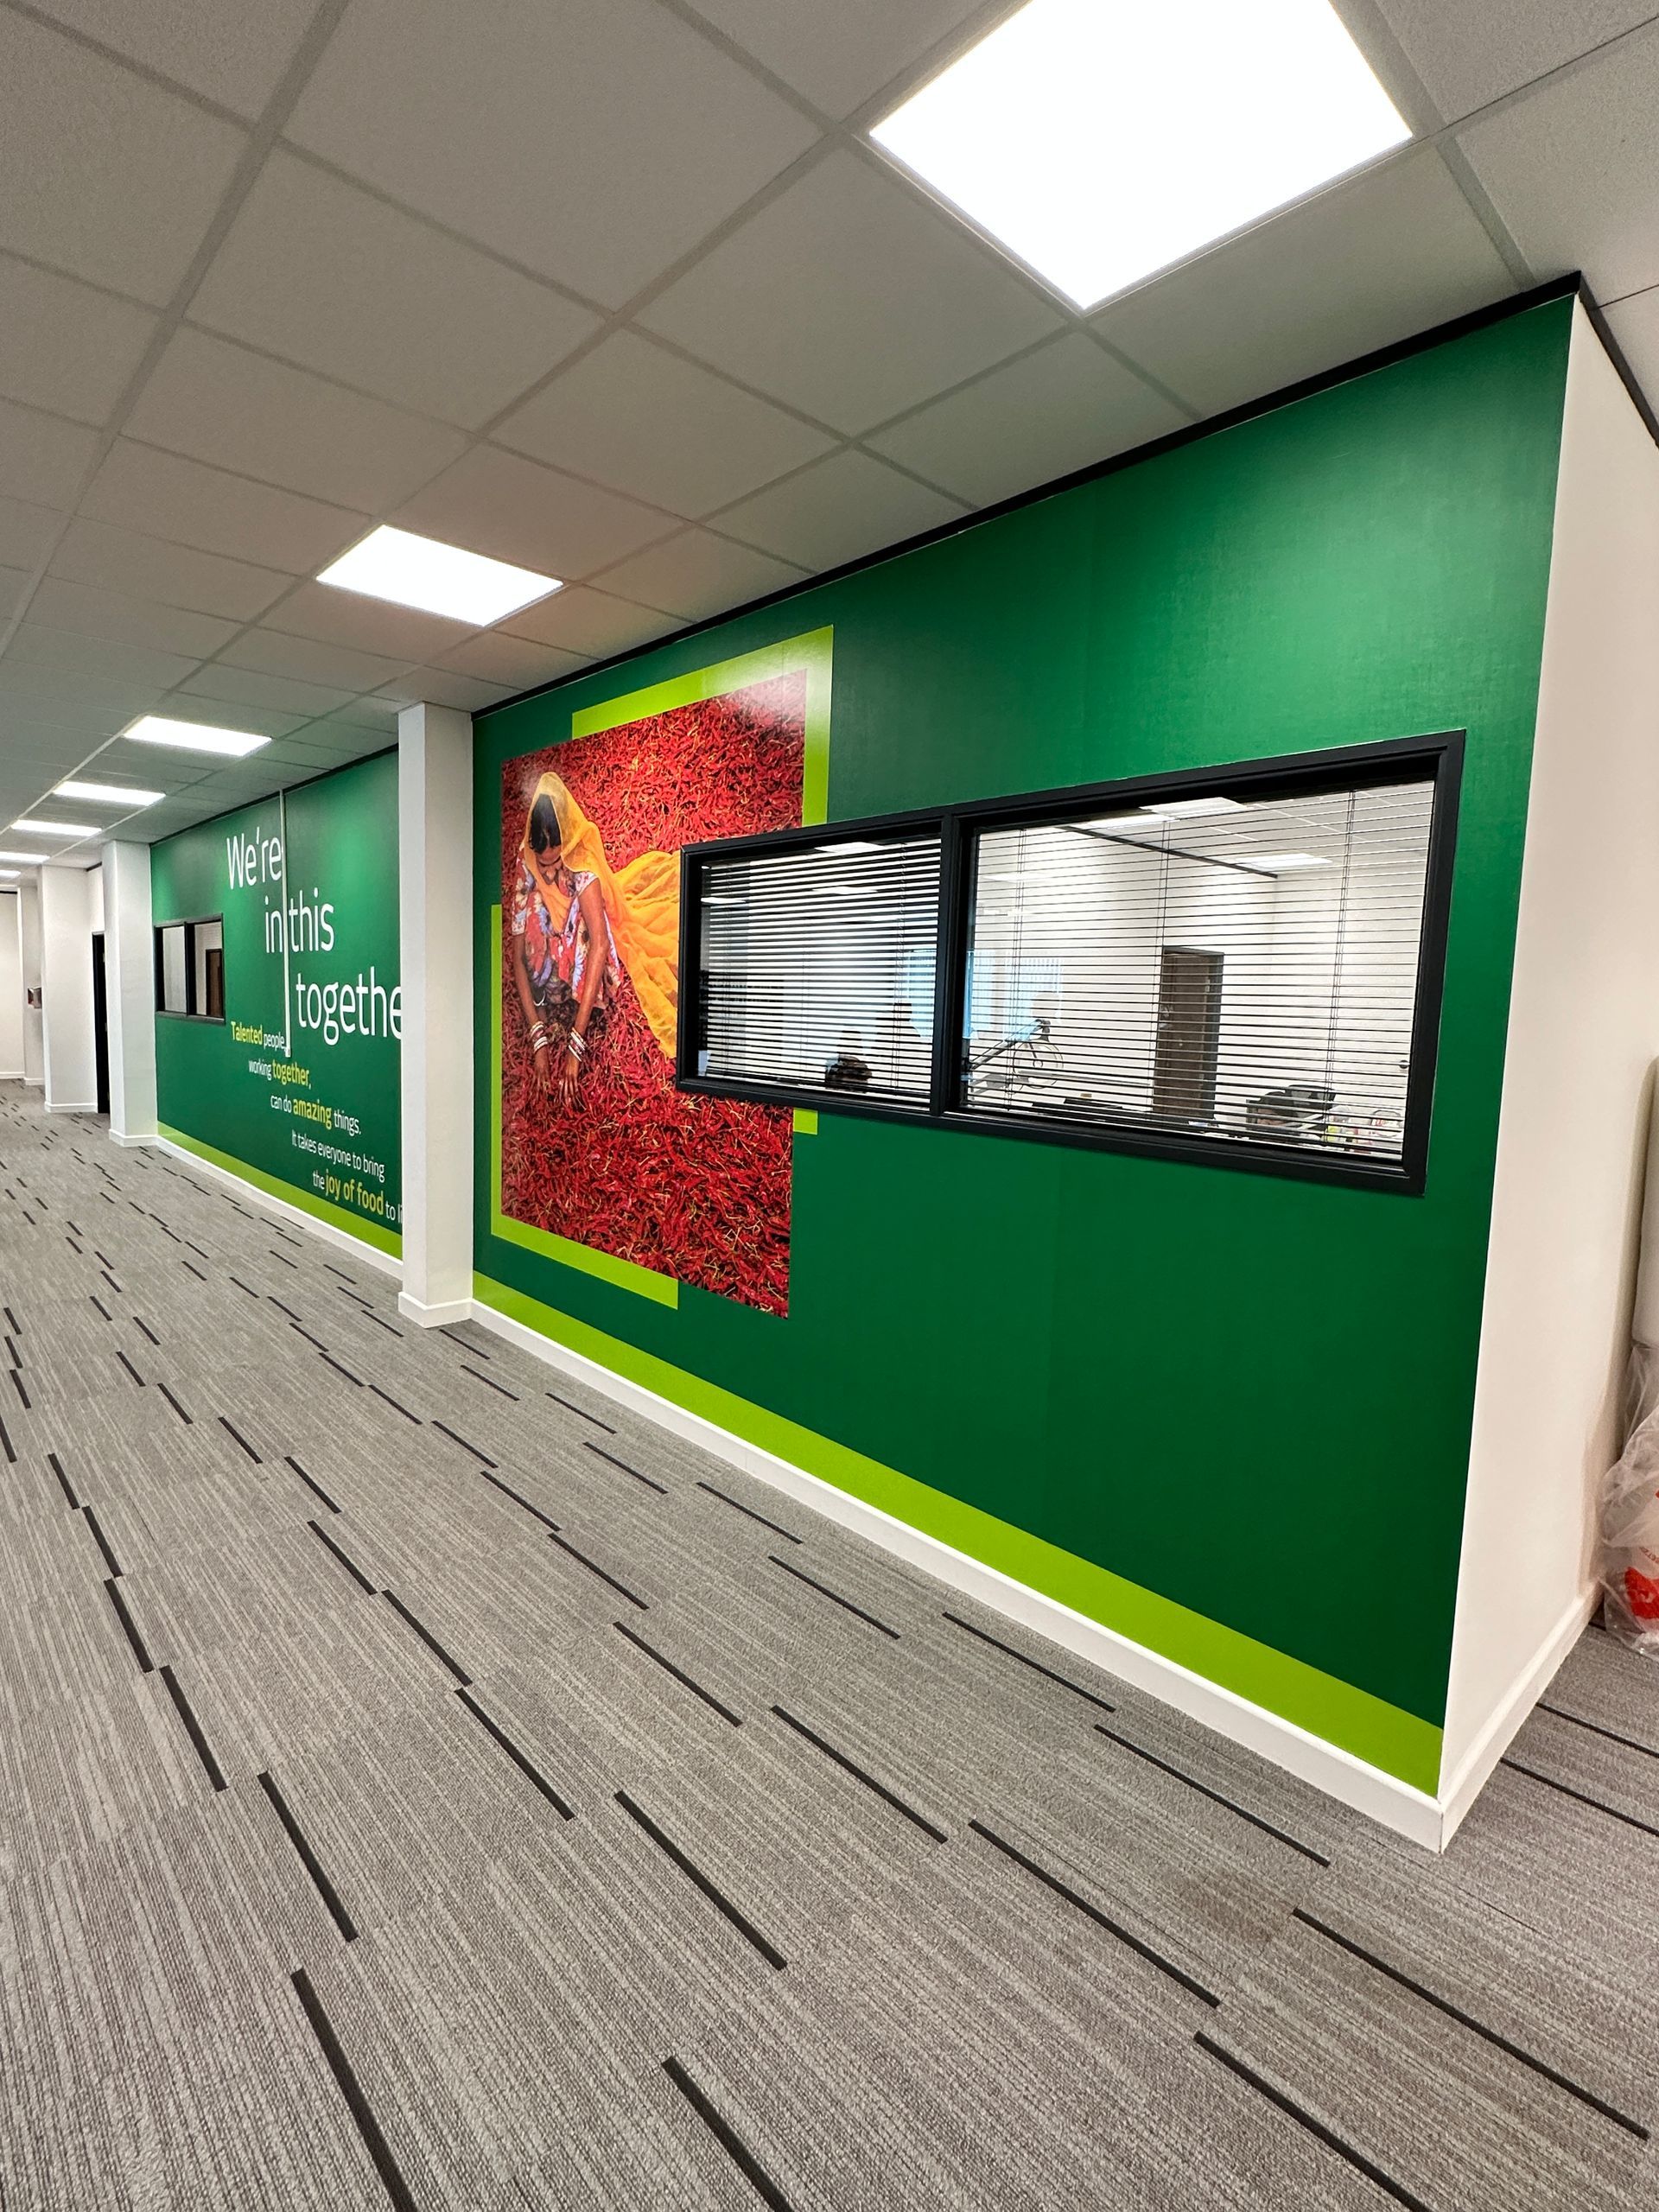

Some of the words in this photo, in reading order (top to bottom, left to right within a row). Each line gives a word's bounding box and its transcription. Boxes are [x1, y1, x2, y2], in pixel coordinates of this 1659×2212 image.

[226, 826, 283, 889] We're
[264, 895, 283, 953] in
[289, 887, 334, 952] this
[231, 1020, 263, 1046] Talented
[249, 1058, 272, 1081] working
[272, 1059, 311, 1090] together,
[270, 1095, 283, 1110] can
[283, 1094, 292, 1113] do
[293, 1098, 332, 1130] amazing
[334, 1109, 361, 1136] things.
[291, 1128, 297, 1147] It
[298, 1132, 317, 1154] takes
[317, 1141, 352, 1166] everyone
[352, 1151, 362, 1171] to
[363, 1153, 385, 1183] bring
[313, 1169, 325, 1190] the
[325, 1168, 341, 1201] joy
[343, 1179, 355, 1199] of
[357, 1184, 385, 1216] food
[385, 1200, 397, 1220] to
